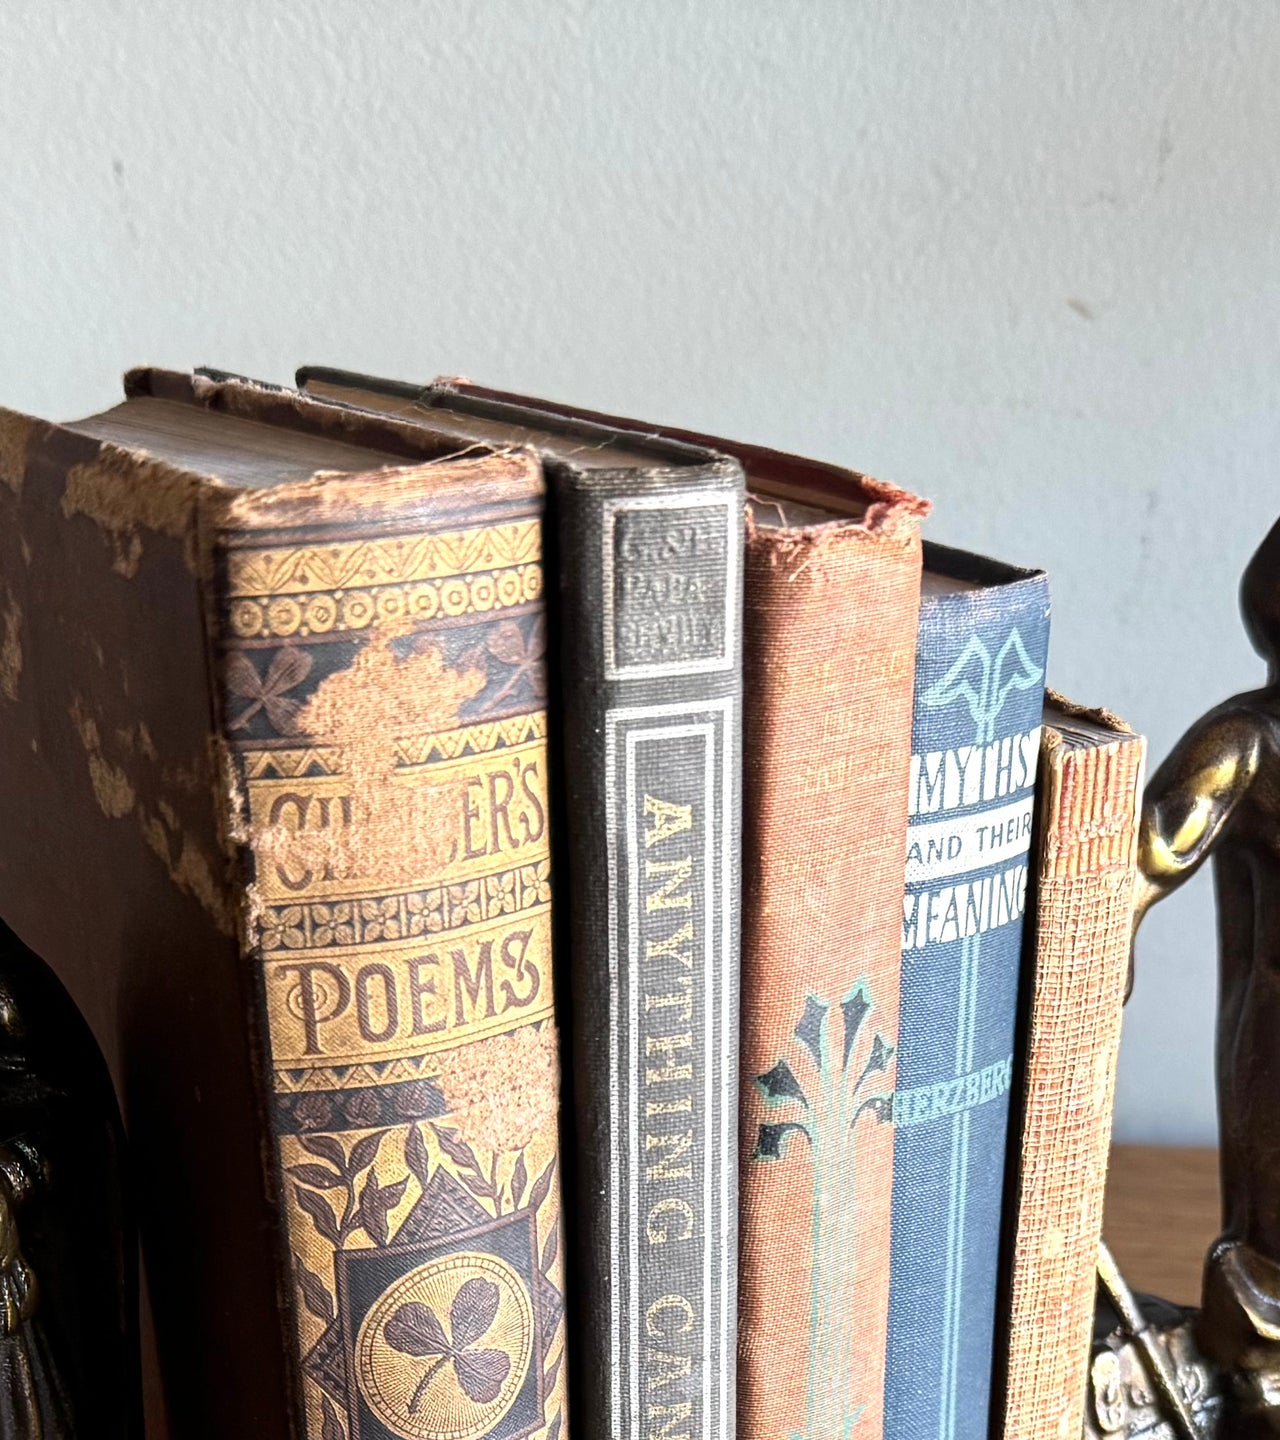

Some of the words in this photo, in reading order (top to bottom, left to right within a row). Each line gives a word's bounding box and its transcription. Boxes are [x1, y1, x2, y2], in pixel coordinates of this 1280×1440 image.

[915, 733, 1031, 814] MYTHS
[906, 835, 962, 864] AND
[976, 812, 1031, 852] THEIR
[275, 929, 541, 1056] POEMS
[643, 794, 695, 1245] ANYTHING
